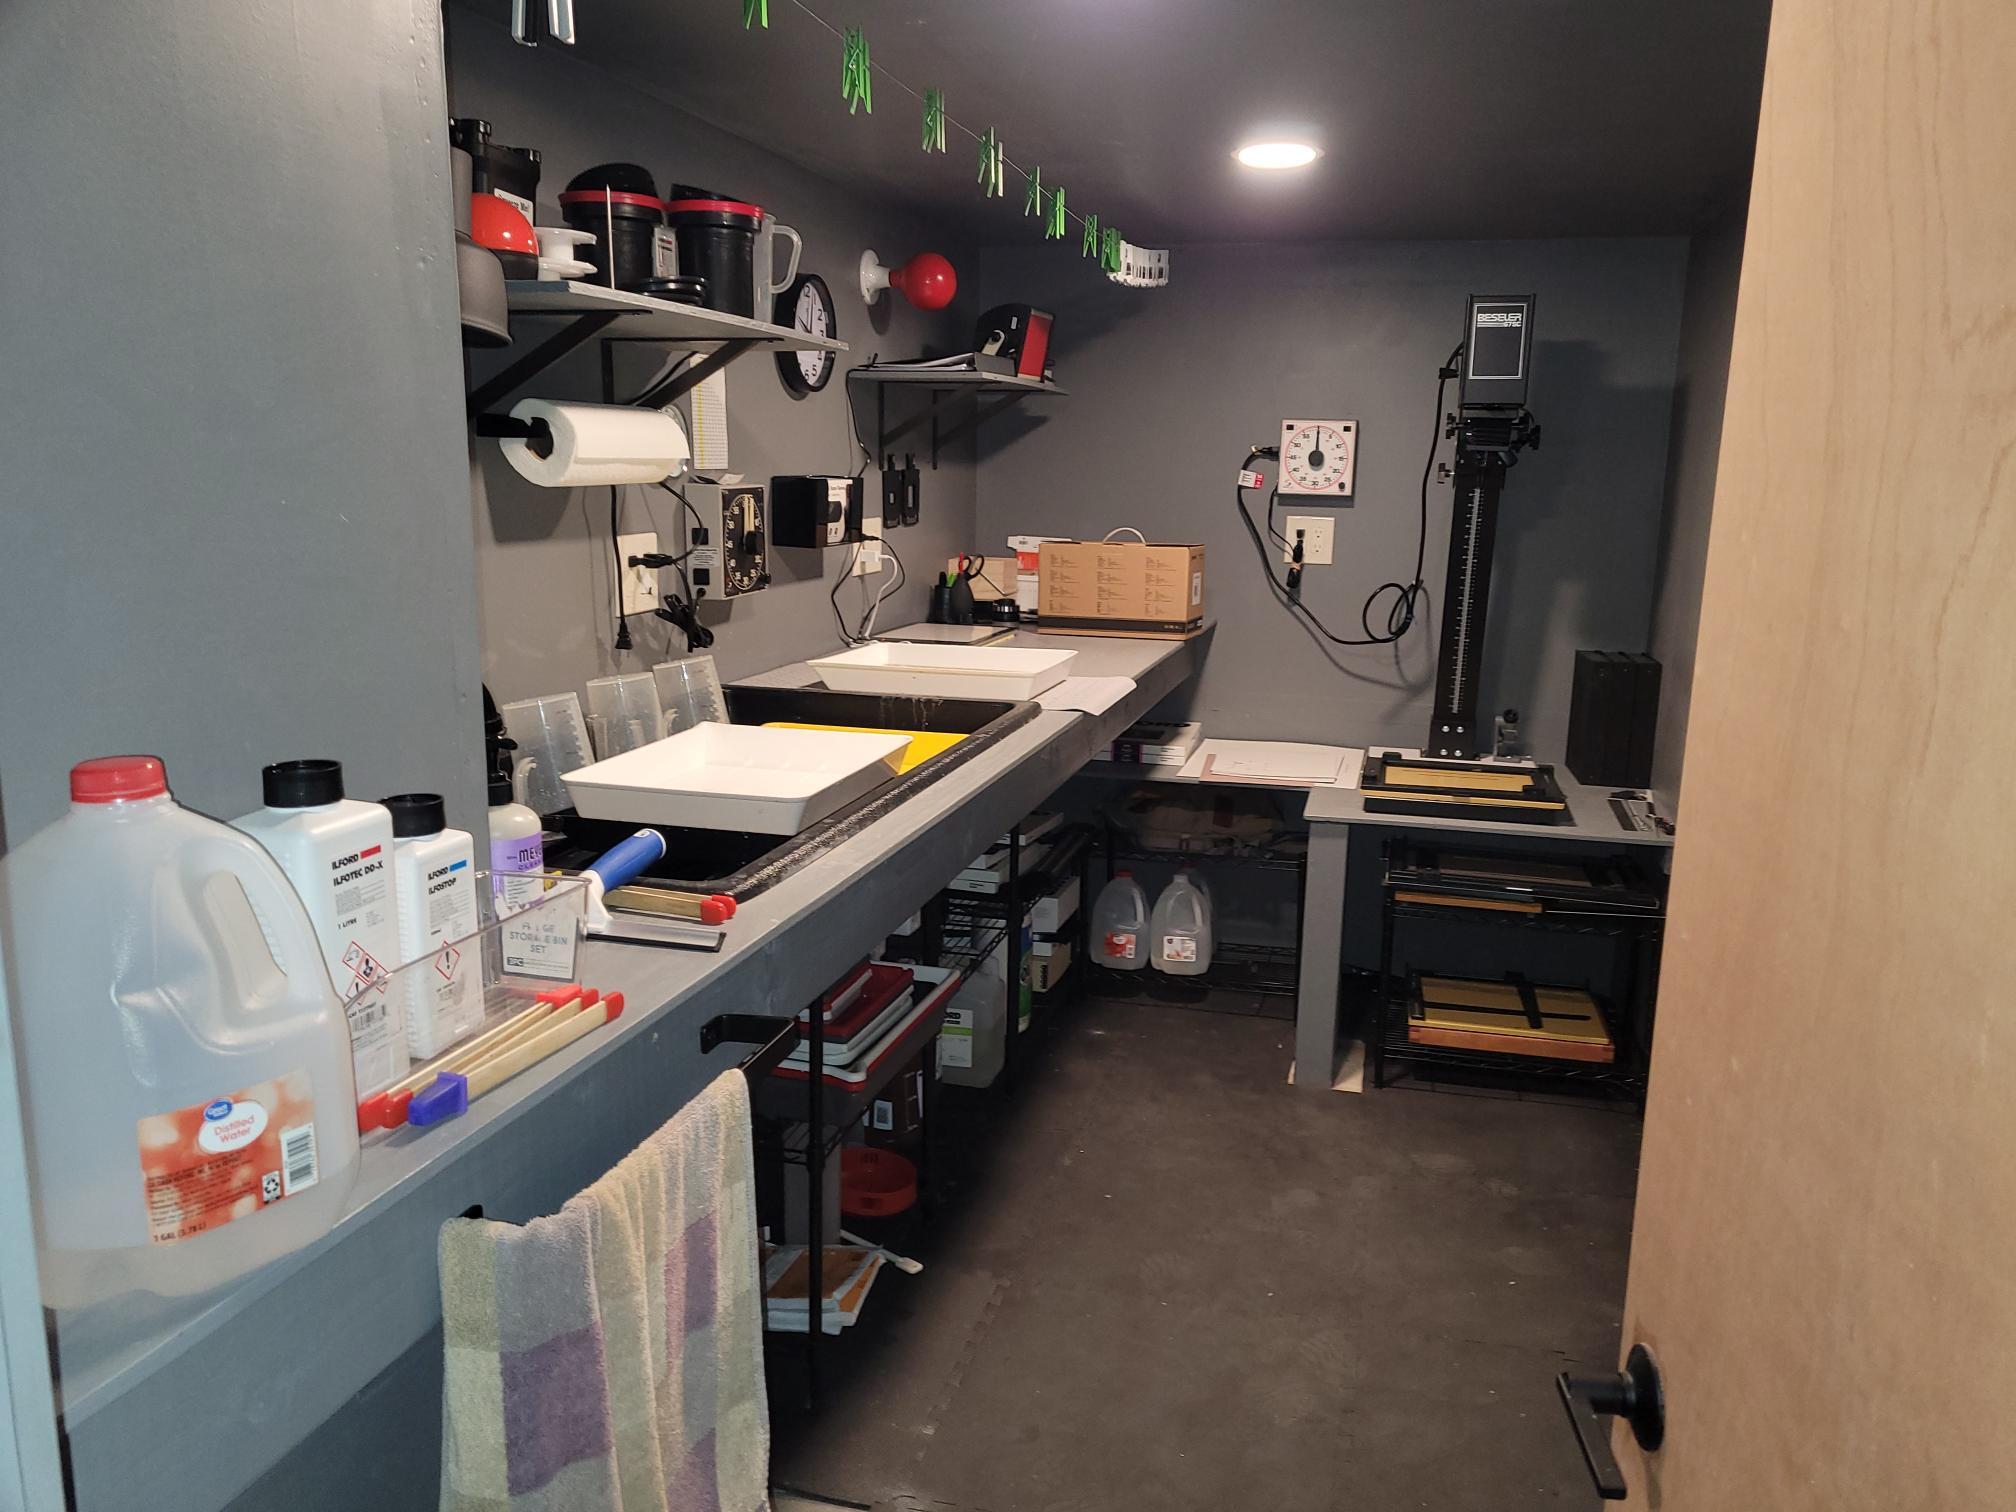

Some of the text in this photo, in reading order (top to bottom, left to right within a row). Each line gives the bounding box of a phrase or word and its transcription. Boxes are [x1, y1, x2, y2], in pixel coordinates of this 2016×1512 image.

[817, 308, 823, 321] 2
[1477, 313, 1522, 322] BESELER
[331, 853, 359, 871] ILFORD
[332, 859, 384, 888] ILFOTEC DD-X
[428, 865, 449, 881] ILFORD
[428, 876, 457, 896] ILFOSTOP
[530, 943, 546, 954] SET
[214, 1114, 255, 1136] Distilled
[219, 1127, 252, 1143] Water
